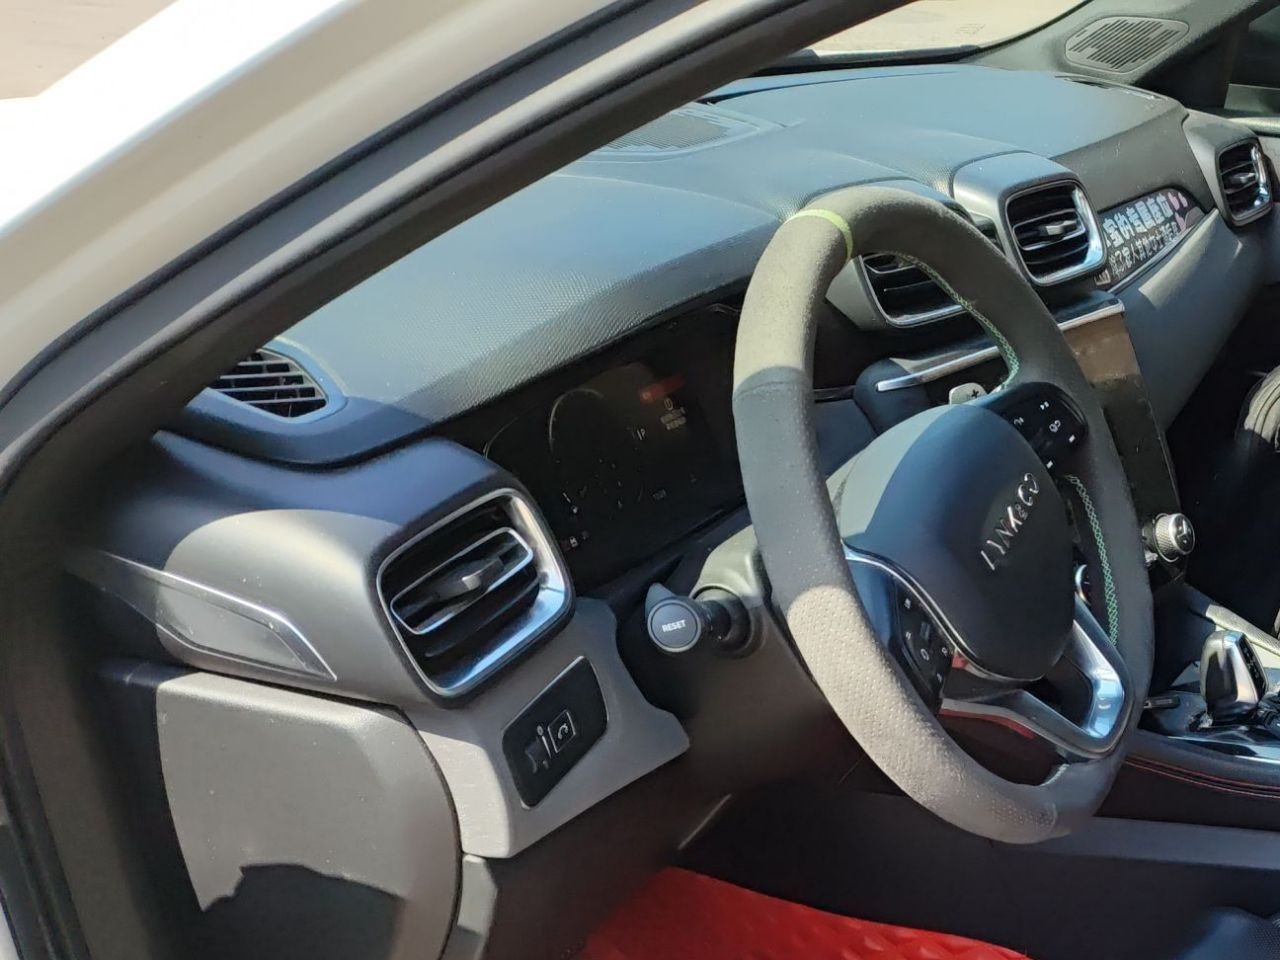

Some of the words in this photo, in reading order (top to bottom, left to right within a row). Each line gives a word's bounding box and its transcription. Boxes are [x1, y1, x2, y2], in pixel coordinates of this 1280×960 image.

[1104, 193, 1173, 247] 宝的专属座位
[661, 619, 687, 633] RESET
